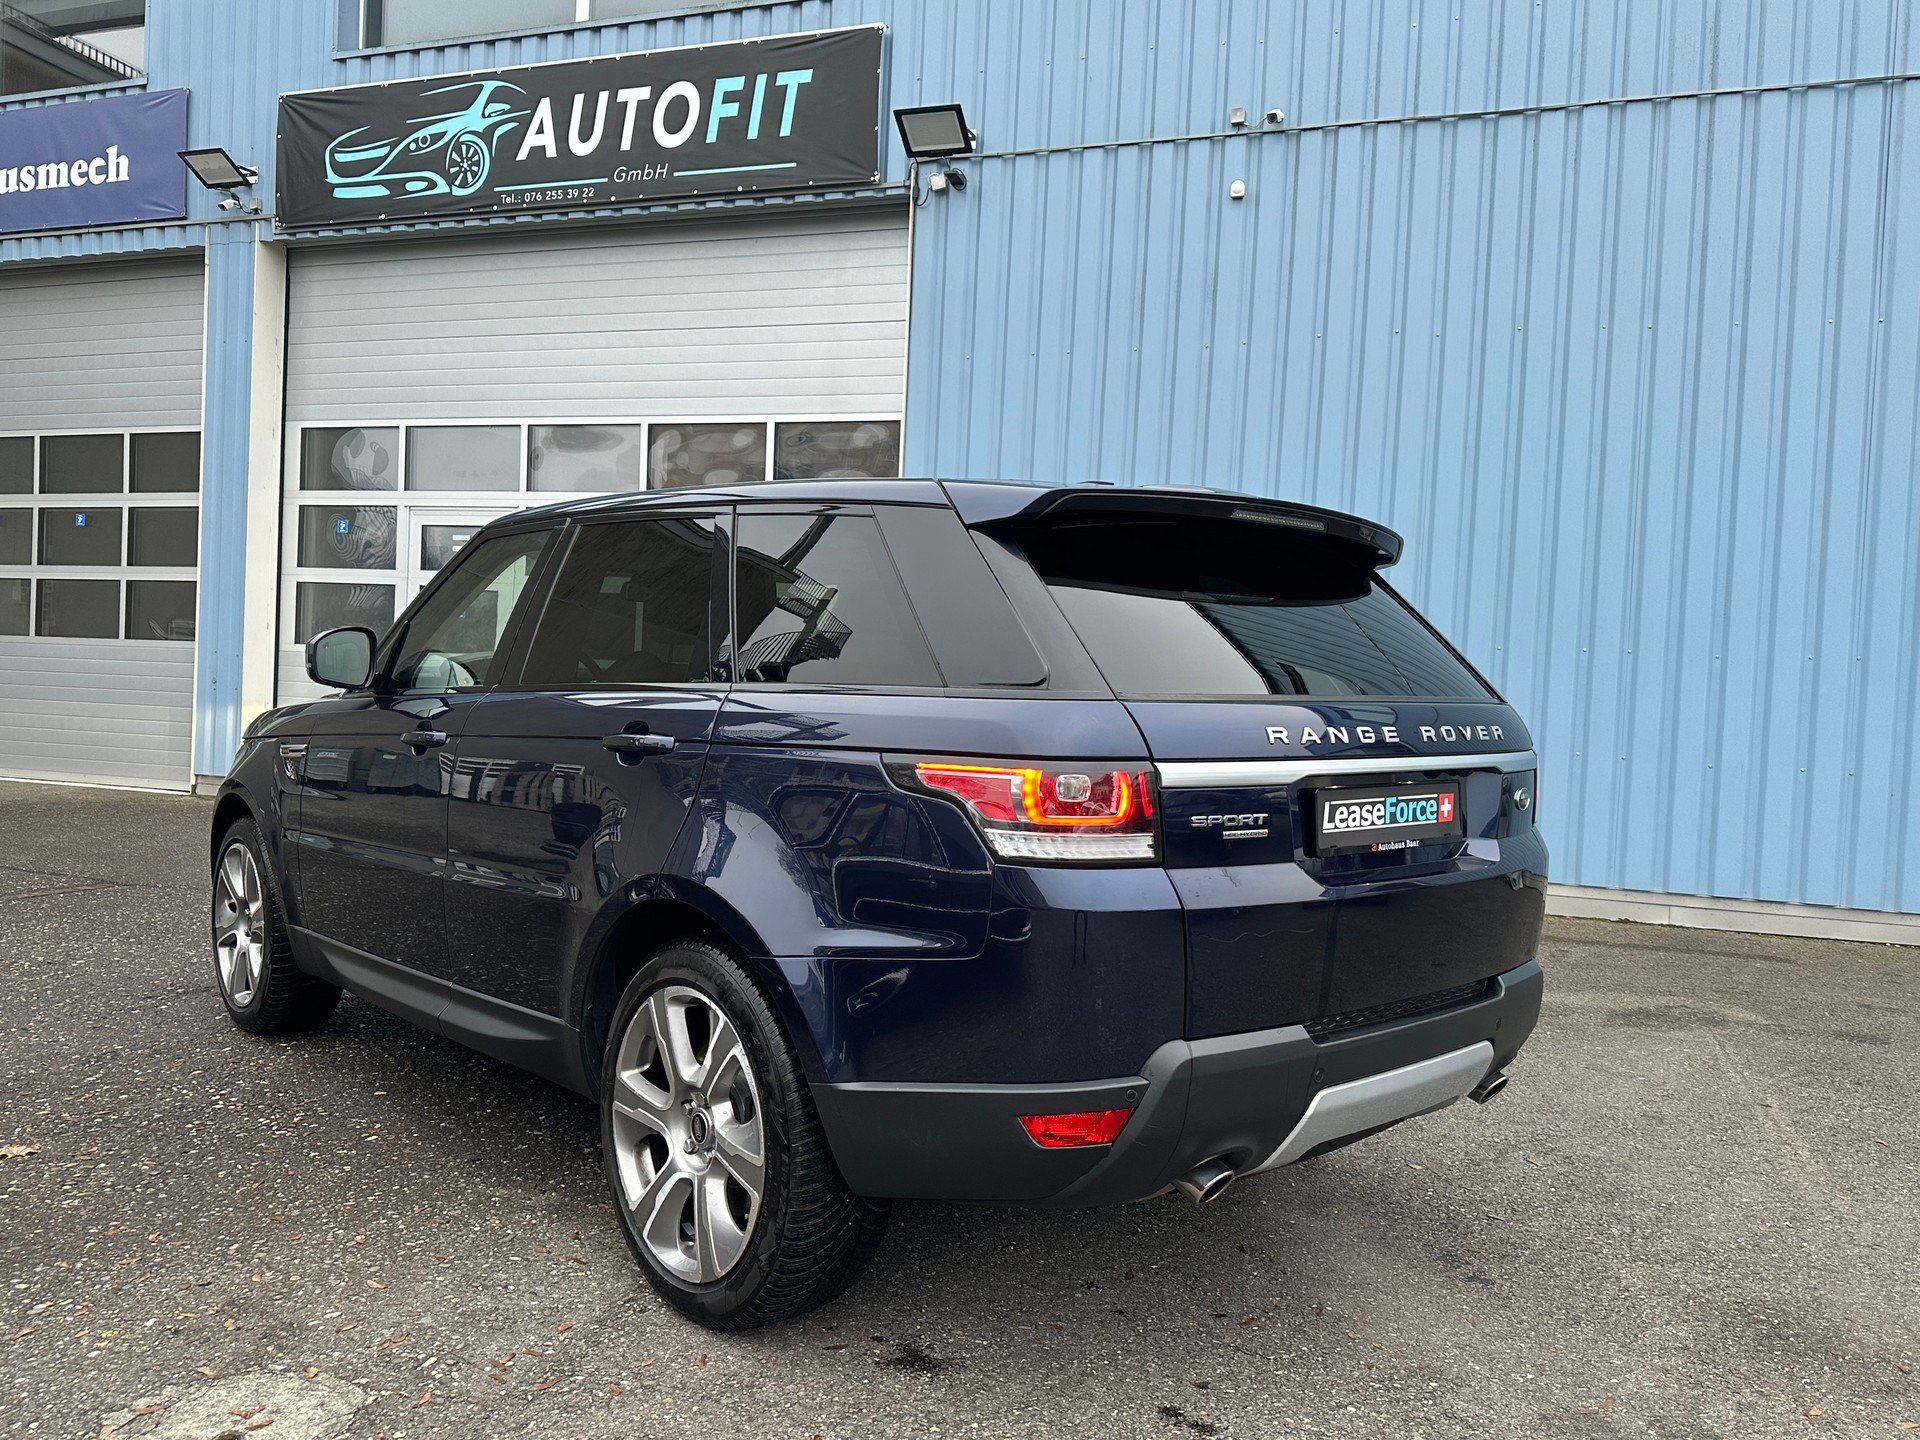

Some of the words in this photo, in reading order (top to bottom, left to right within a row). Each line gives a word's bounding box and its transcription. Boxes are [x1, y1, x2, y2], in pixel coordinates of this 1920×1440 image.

[515, 68, 813, 161] AUTOFIT
[0, 144, 130, 194] usmech
[613, 163, 669, 183] GmbH
[501, 194, 521, 204] Tel.:
[524, 191, 542, 203] 076
[545, 190, 564, 201] 255
[566, 188, 579, 199] 39
[582, 187, 595, 198] 22
[1265, 726, 1400, 744] RANGE
[1418, 725, 1504, 743] ROVER
[1191, 813, 1268, 827] SPORT
[1322, 796, 1438, 829] LeaseForce
[1377, 841, 1405, 851] Autohaus
[1406, 839, 1420, 849] Baar
